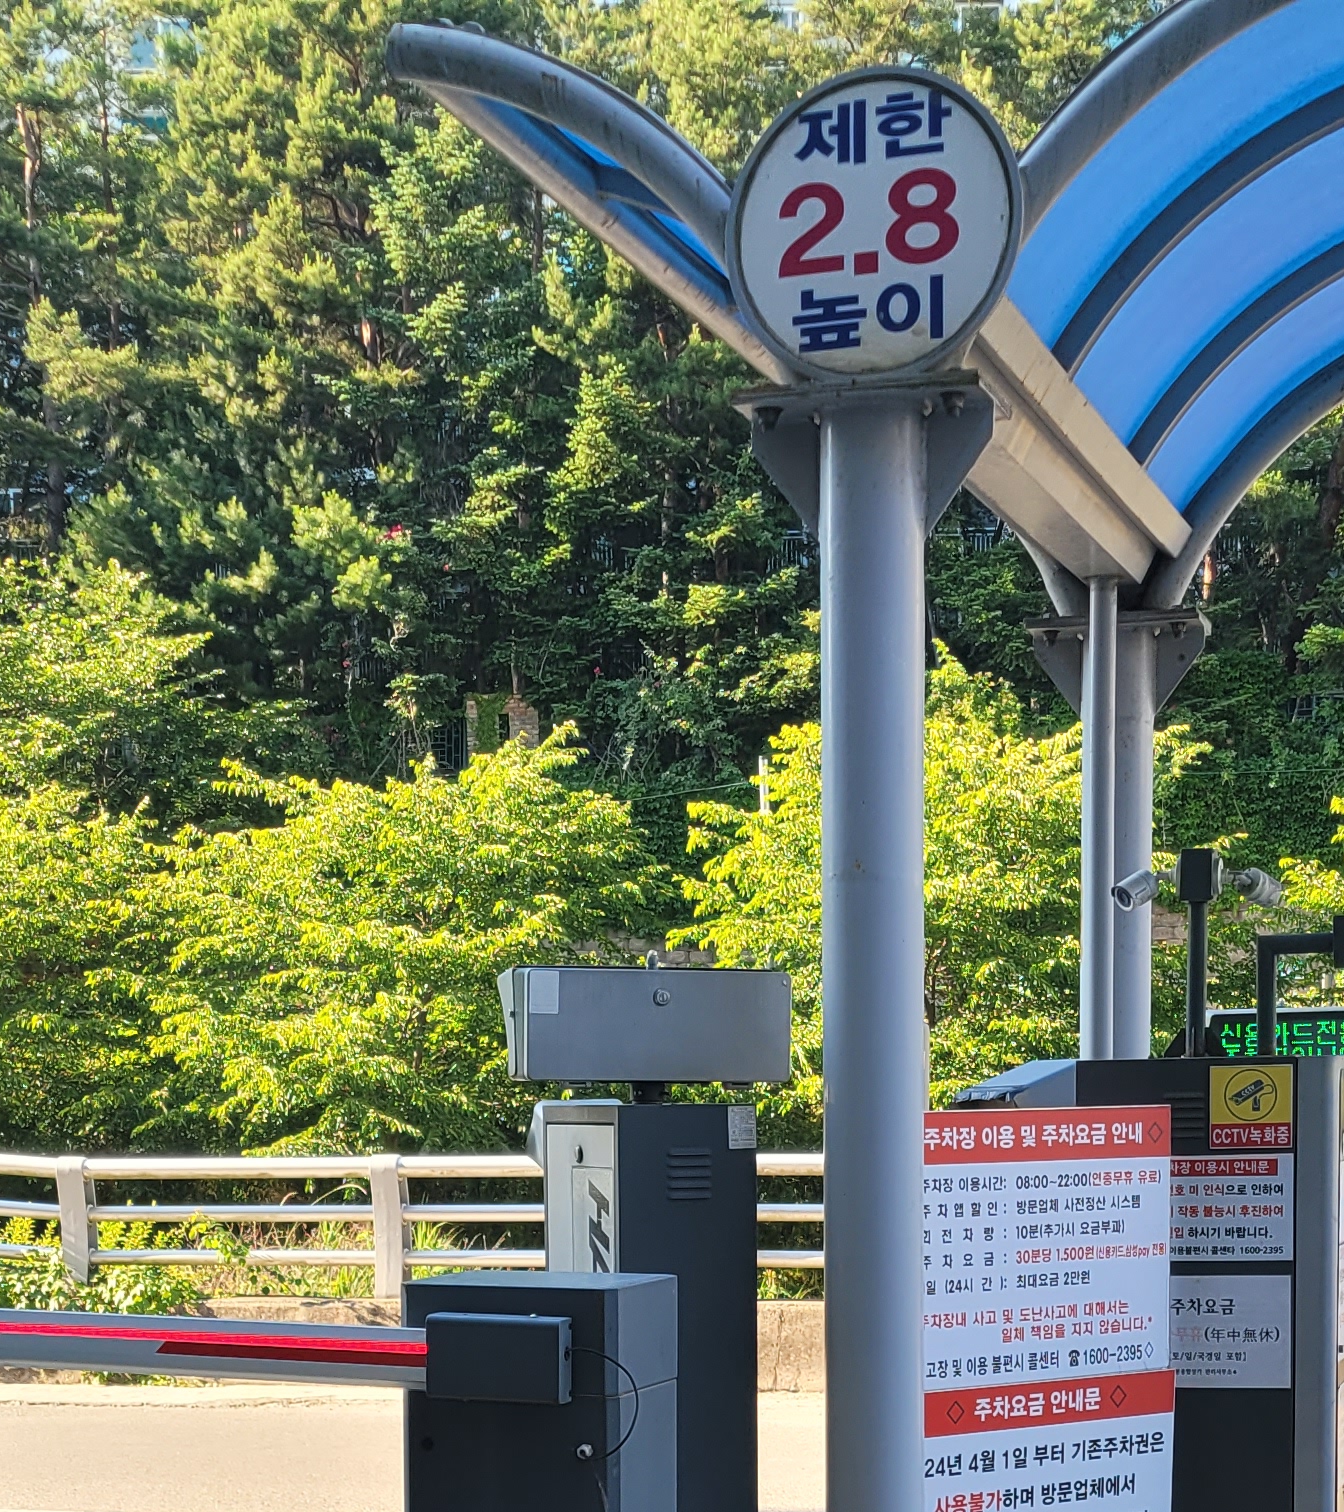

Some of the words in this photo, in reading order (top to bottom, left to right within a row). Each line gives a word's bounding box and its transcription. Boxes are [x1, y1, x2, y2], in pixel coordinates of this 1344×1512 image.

[795, 88, 952, 165] 제한
[778, 167, 959, 278] 2.8
[792, 274, 944, 353] 높이
[923, 1127, 977, 1150] 주차장
[981, 1125, 1015, 1148] 이용
[1020, 1125, 1037, 1147] 및
[1041, 1123, 1107, 1147] 주차요금
[1111, 1122, 1143, 1144] 안내
[1213, 1126, 1290, 1144] CCTV녹화중
[1194, 1161, 1229, 1174] 이용시
[1233, 1160, 1269, 1173] 안내문
[1189, 1184, 1199, 1197] 미
[1203, 1184, 1248, 1197] 인식으로
[1251, 1183, 1284, 1196] 인하여
[1016, 1198, 1059, 1215] 방문업체
[1064, 1196, 1106, 1212] 사전정산
[1111, 1195, 1140, 1210] 시스템
[1177, 1205, 1200, 1218] 작동
[1239, 1205, 1284, 1217] 후진하여
[1187, 1226, 1221, 1239] 하시기
[1224, 1226, 1273, 1239] 바랍니다.
[1016, 1247, 1051, 1264] 30분당
[1240, 1246, 1284, 1255] 1600-2395
[1016, 1272, 1059, 1289] 최대요금
[1064, 1270, 1090, 1286] 2만원
[973, 1310, 997, 1326] 사고
[1003, 1308, 1013, 1325] 및
[1019, 1304, 1077, 1322] 도난사고에
[1084, 1300, 1129, 1317] 대해서는
[1170, 1298, 1236, 1316] 주차요금
[1002, 1327, 1025, 1343] 일체
[1031, 1323, 1066, 1340] 책임을
[1071, 1321, 1093, 1336] 지지
[926, 1360, 948, 1378] 고장
[952, 1358, 962, 1377] 및
[967, 1356, 988, 1376] 이용
[992, 1353, 1024, 1374] 불편시
[1027, 1350, 1059, 1370] 콜센터
[974, 1393, 1045, 1422] 주차요금
[1050, 1387, 1102, 1414] 안내문
[924, 1453, 962, 1478] 24년
[968, 1451, 995, 1473] 4월
[1002, 1446, 1027, 1469] 1일
[1033, 1442, 1065, 1467] 부터
[1072, 1432, 1164, 1461] 기존주차권은
[1041, 1473, 1136, 1506] 방문업체에서
